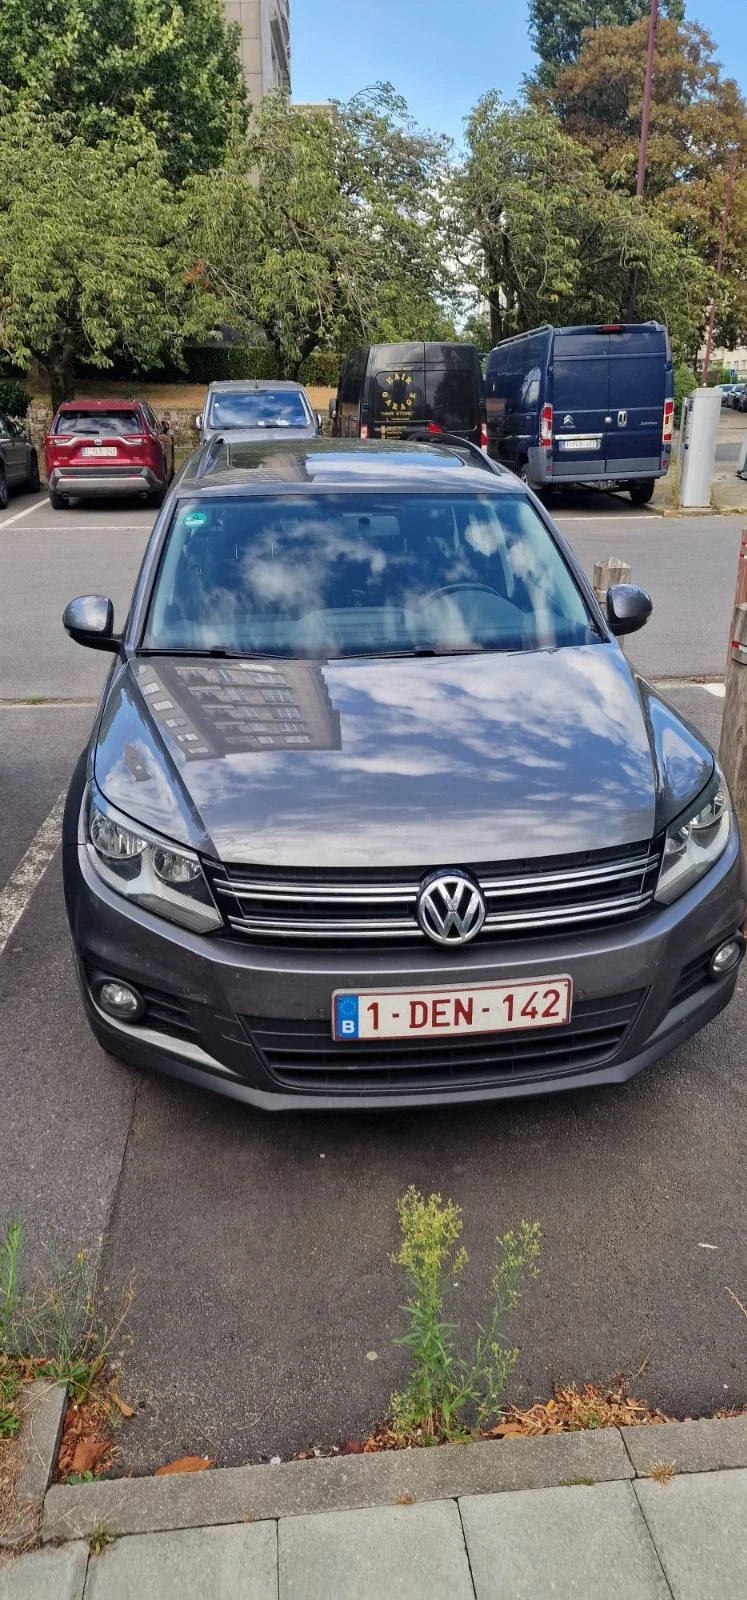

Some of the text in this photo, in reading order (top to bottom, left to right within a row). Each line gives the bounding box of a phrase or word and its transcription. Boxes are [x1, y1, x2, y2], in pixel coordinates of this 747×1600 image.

[386, 373, 412, 384] HAIR
[382, 391, 416, 410] GARAGE
[420, 876, 485, 944] VW
[341, 1020, 355, 1033] B
